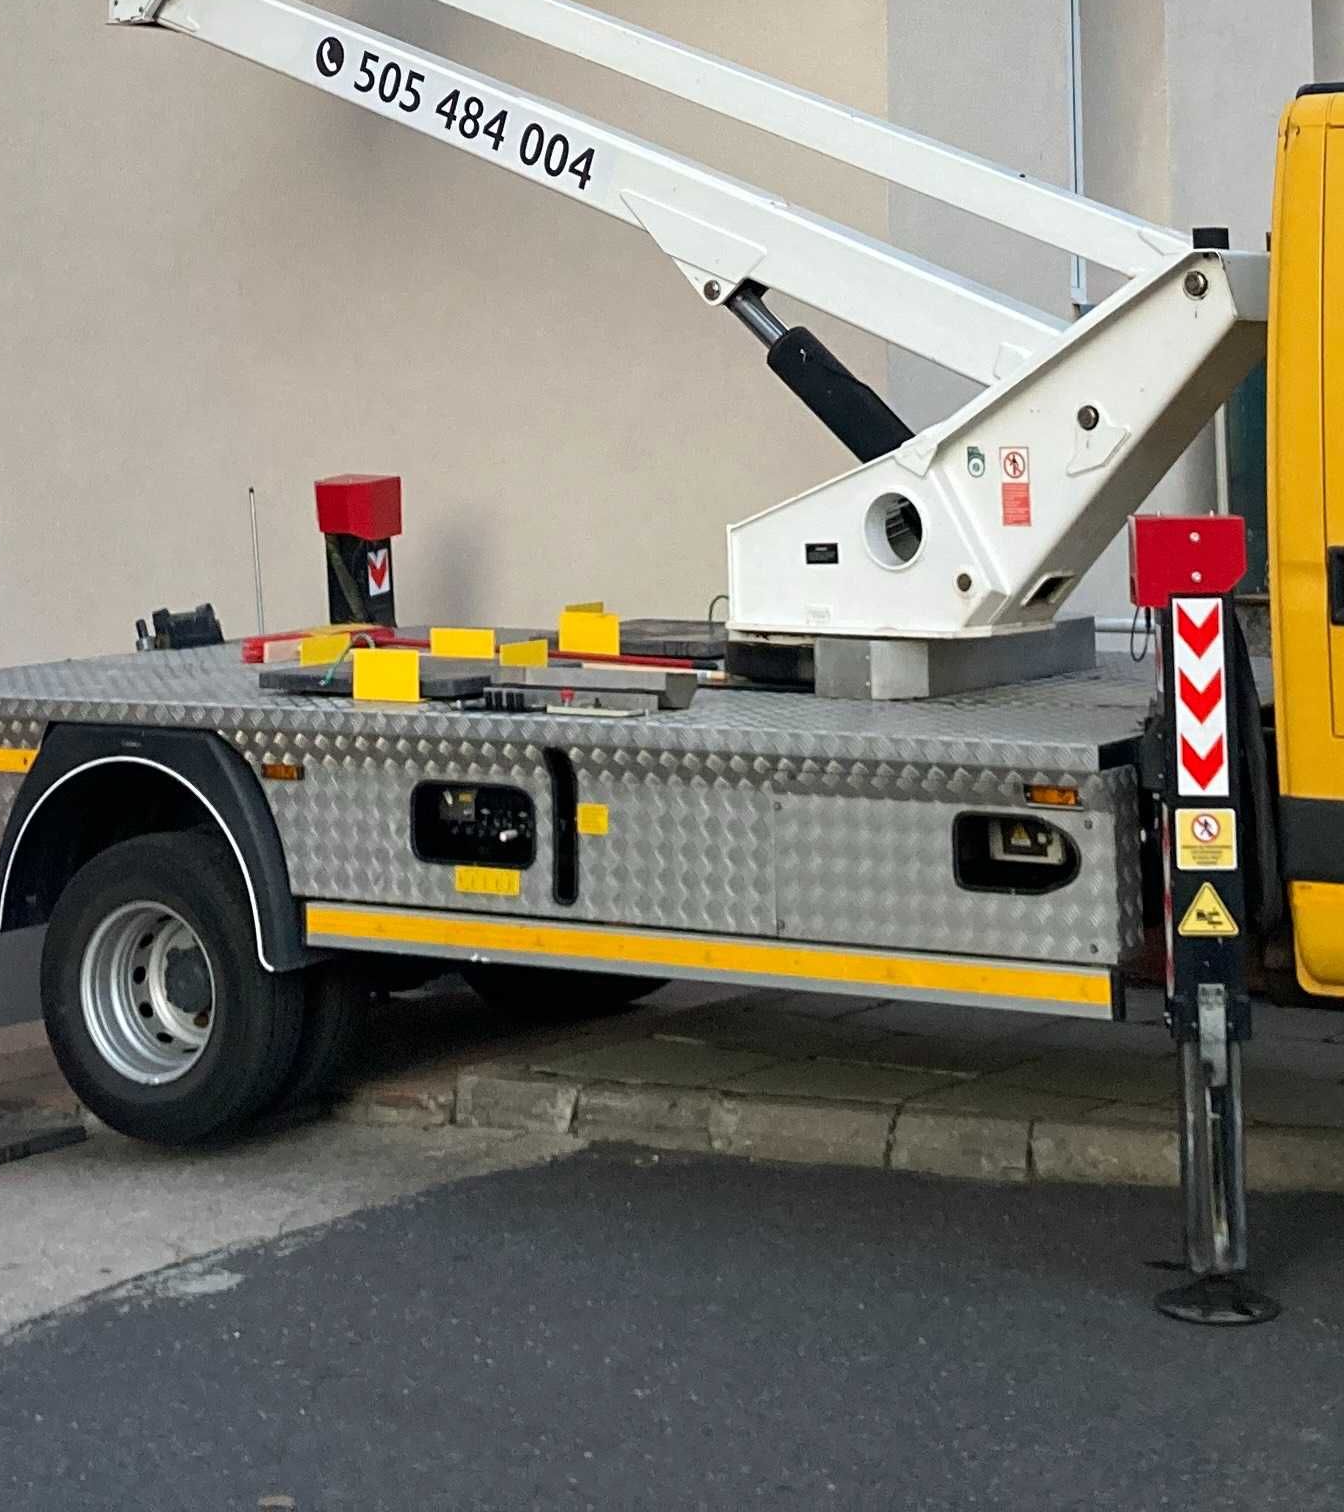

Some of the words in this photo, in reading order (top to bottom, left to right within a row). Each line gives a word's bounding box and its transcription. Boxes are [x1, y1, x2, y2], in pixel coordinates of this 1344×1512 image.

[353, 49, 425, 113] 505
[435, 88, 509, 152] 484
[519, 122, 596, 191] 004
